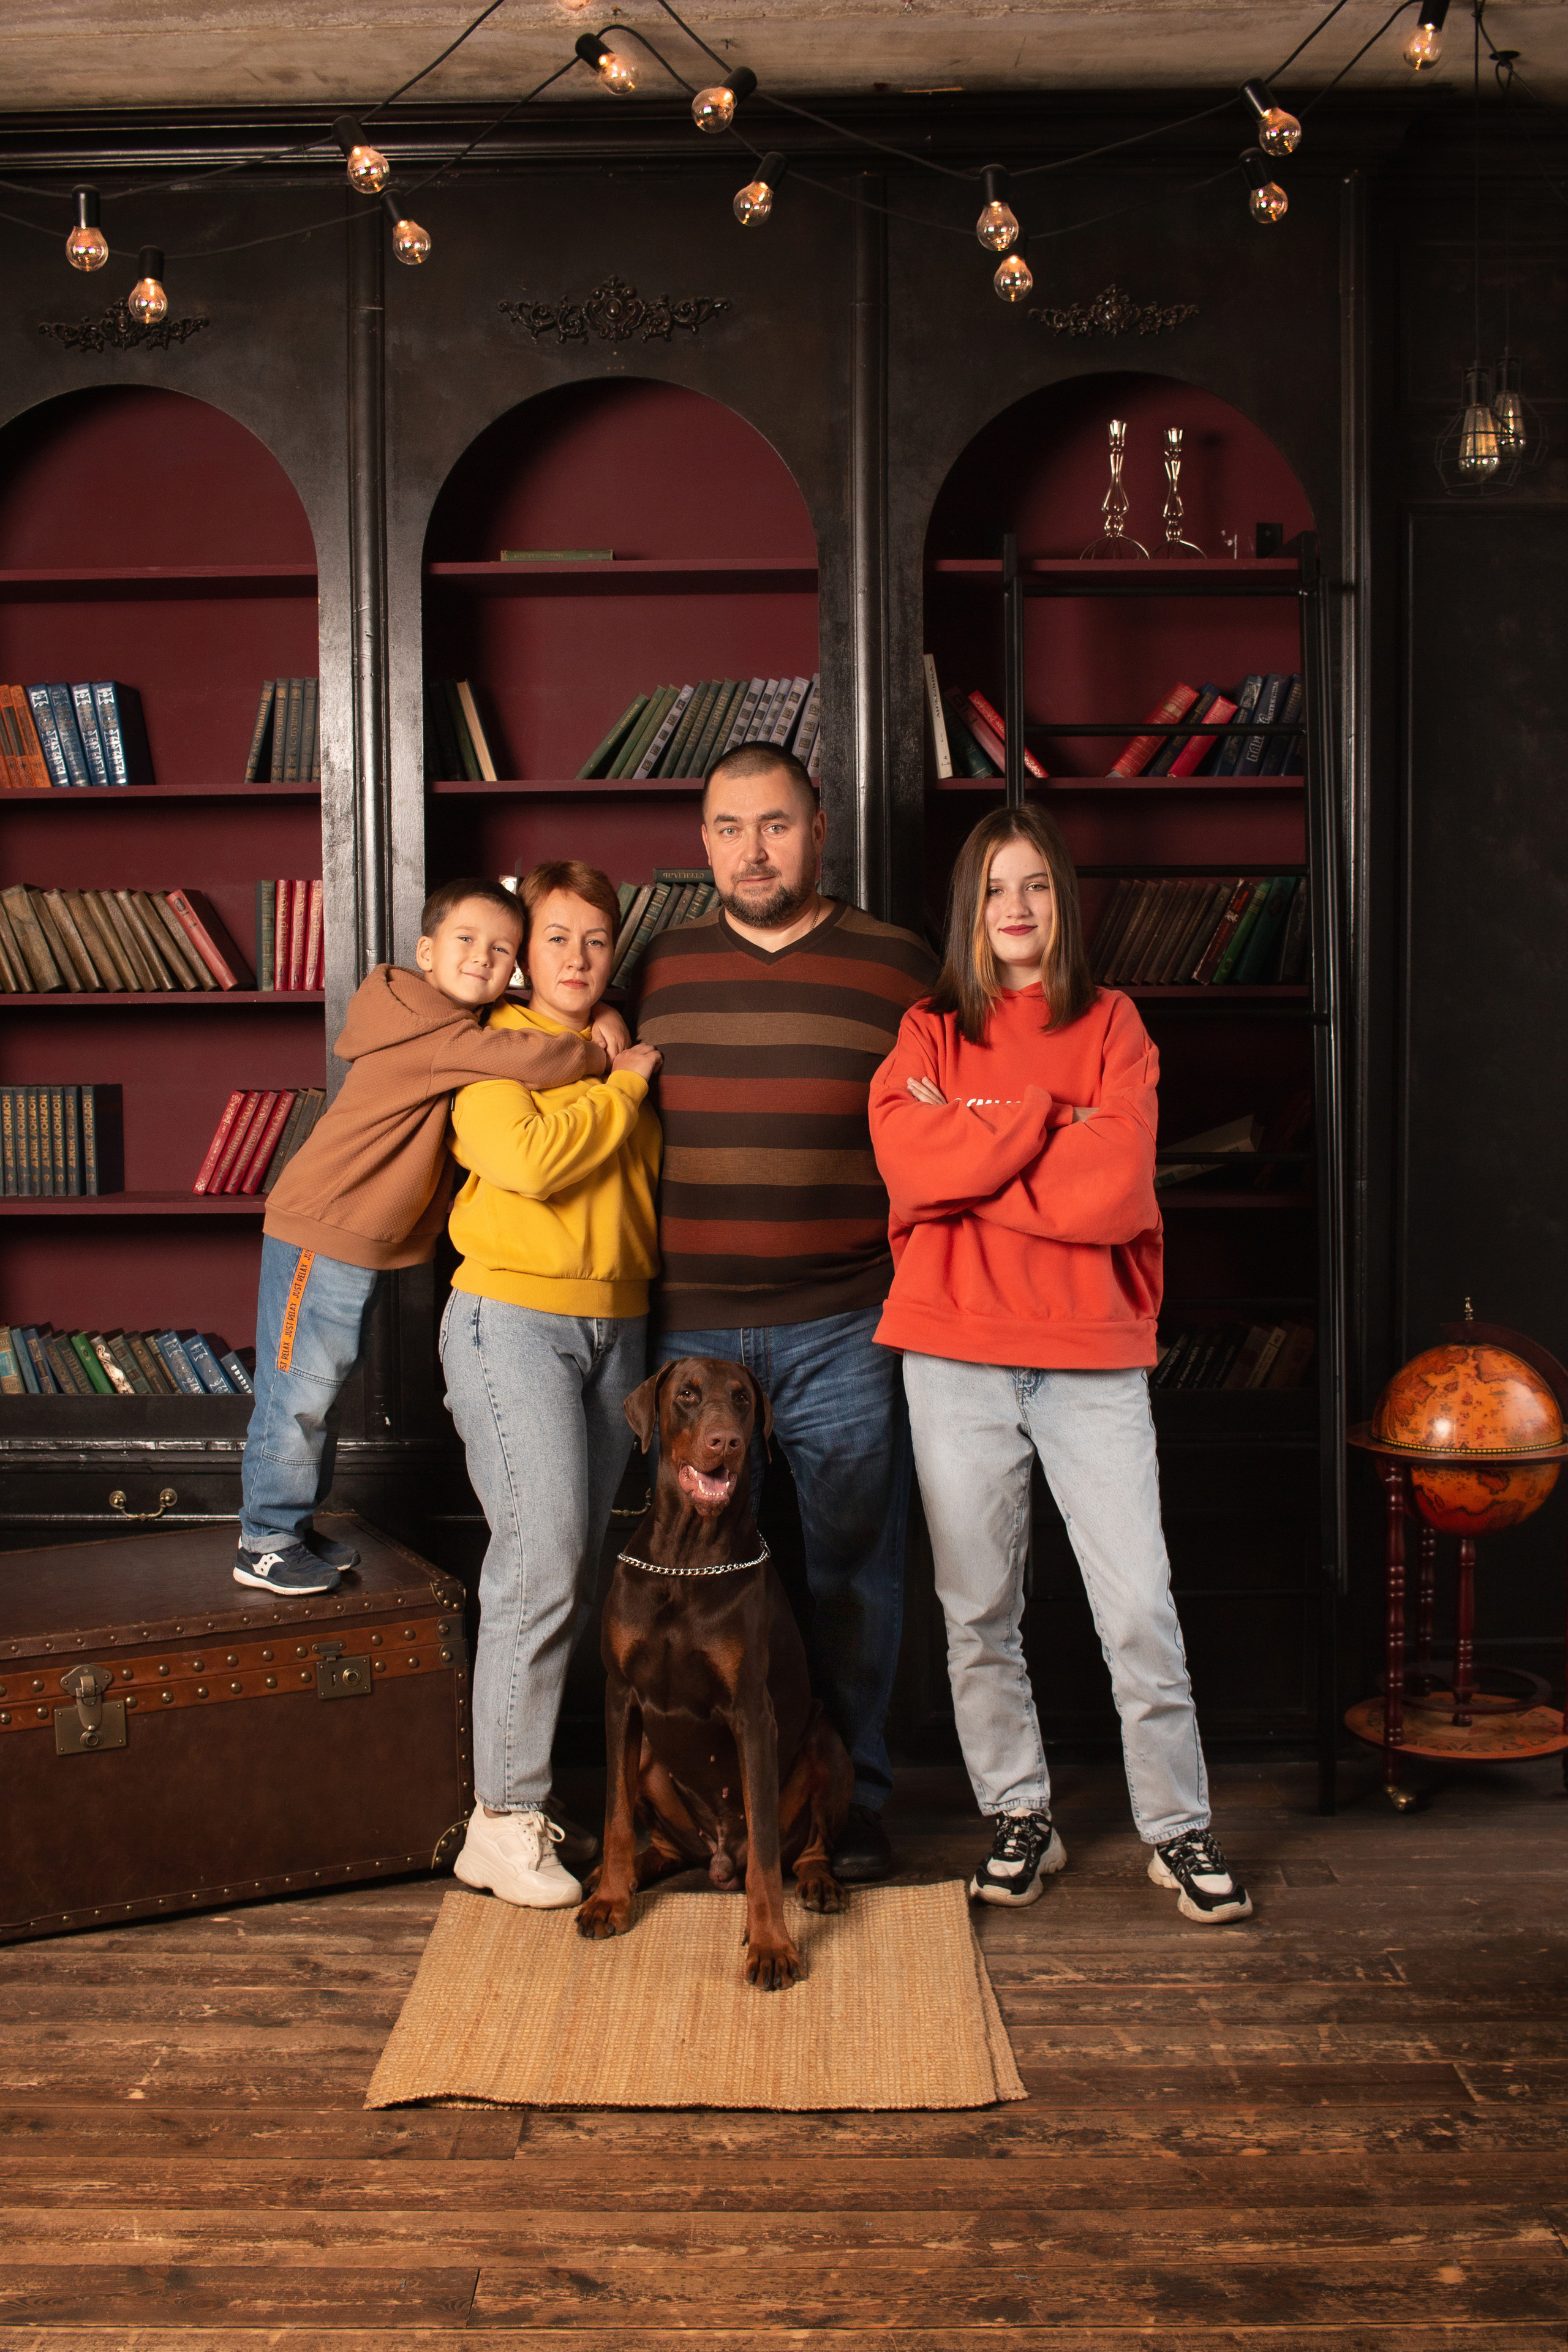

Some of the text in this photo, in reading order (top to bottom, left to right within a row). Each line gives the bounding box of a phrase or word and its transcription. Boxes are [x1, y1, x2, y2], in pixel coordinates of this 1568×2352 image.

[2, 1095, 13, 1168] ДЖЕК ЛОНДОН
[17, 1095, 27, 1168] ДЖЕК ЛОНДОН
[28, 1095, 37, 1137] ЛОНДОН
[39, 1095, 50, 1168] ДЖЕК ЛОНДОН
[52, 1095, 63, 1168] ДЖЕК ЛОНДОН
[66, 1095, 76, 1169] ДЖЕК ЛОНДОН
[83, 1095, 94, 1168] ДЖЕК ЛОНДОН
[293, 1264, 308, 1298] JUST RELAX
[281, 1341, 290, 1360] RELAX
[285, 1302, 297, 1338] JUST RELAX
